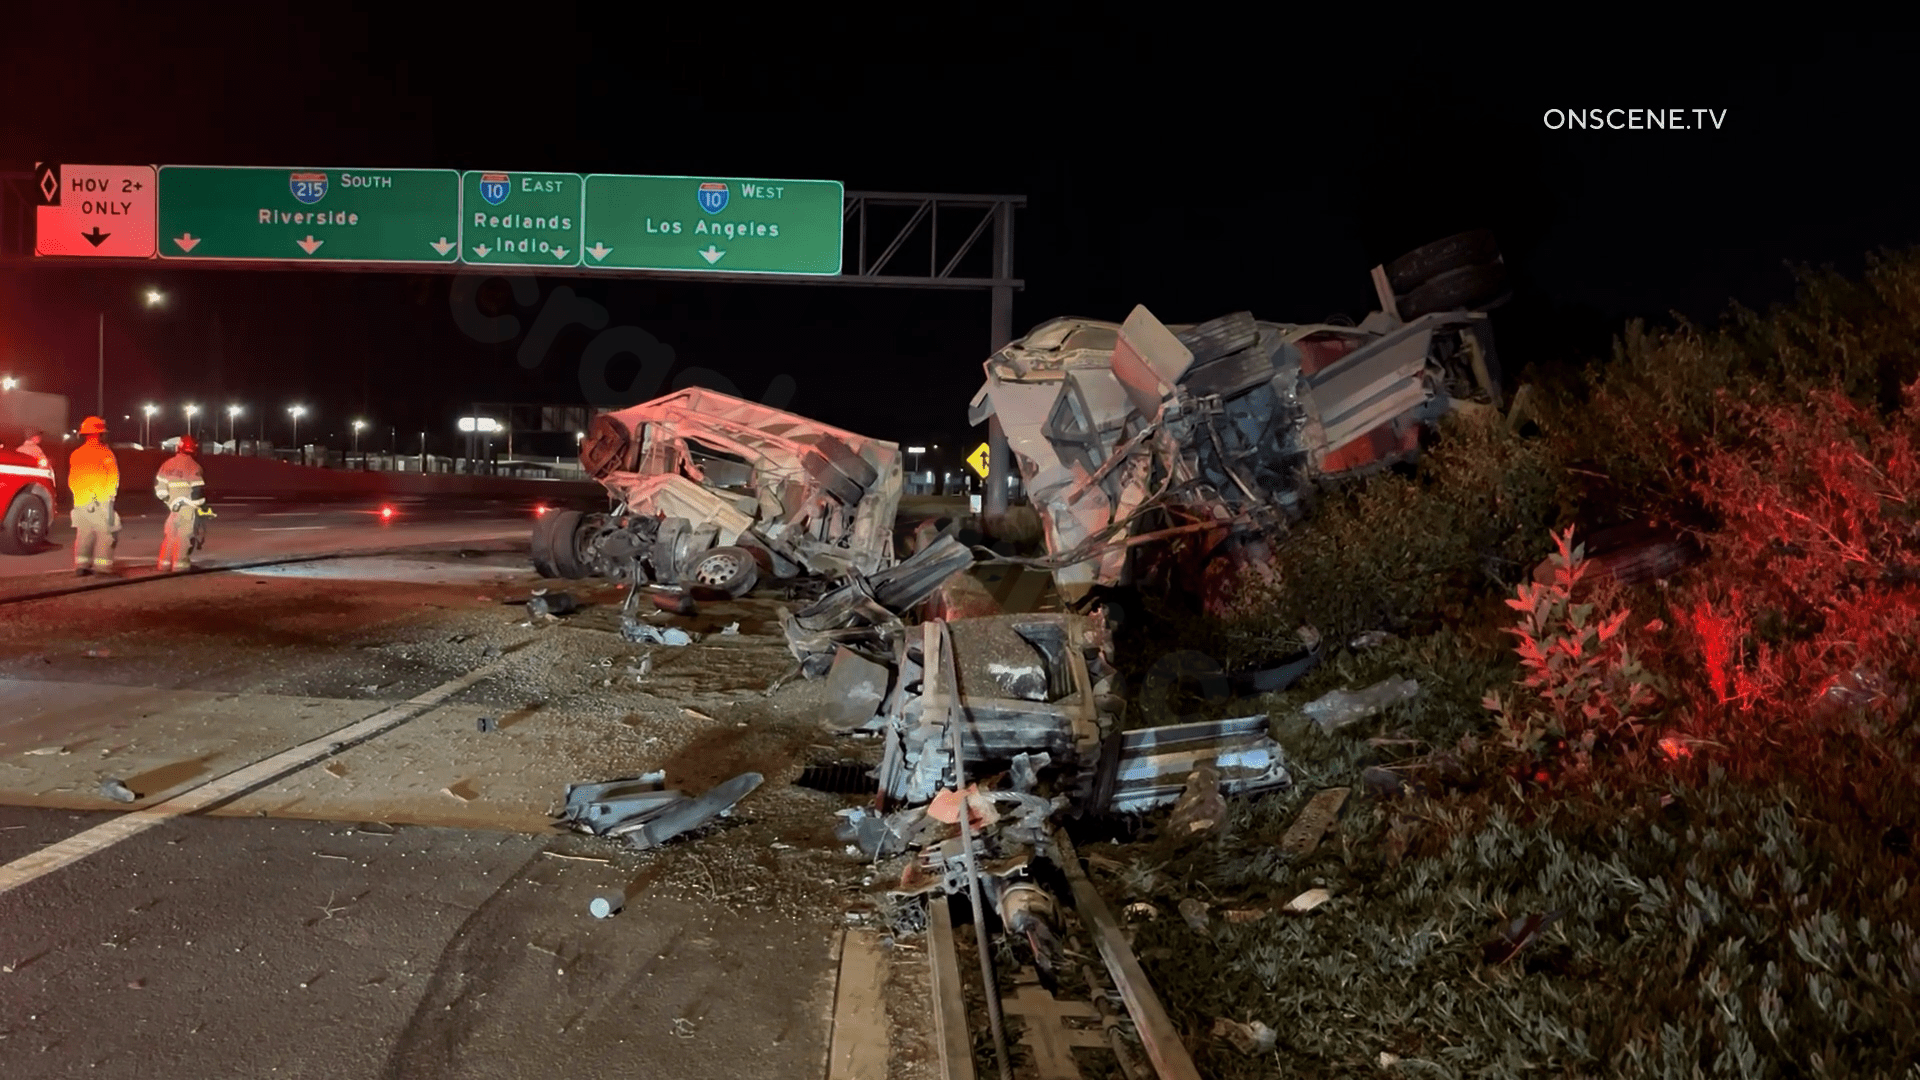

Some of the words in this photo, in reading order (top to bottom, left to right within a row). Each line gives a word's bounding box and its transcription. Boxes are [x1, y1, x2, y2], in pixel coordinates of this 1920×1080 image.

[72, 178, 109, 192] HOV
[121, 179, 143, 193] 2+
[340, 173, 392, 188] SOUTH
[521, 178, 563, 192] EAST
[296, 182, 324, 197] 215
[487, 184, 504, 199] 10
[741, 183, 784, 199] WEST
[705, 192, 722, 208] 10
[81, 201, 132, 215] ONLY
[258, 208, 359, 225] Riverside
[474, 213, 572, 230] Redlands
[646, 218, 682, 234] Los
[695, 219, 780, 240] Angeles
[497, 237, 549, 253] Indio
